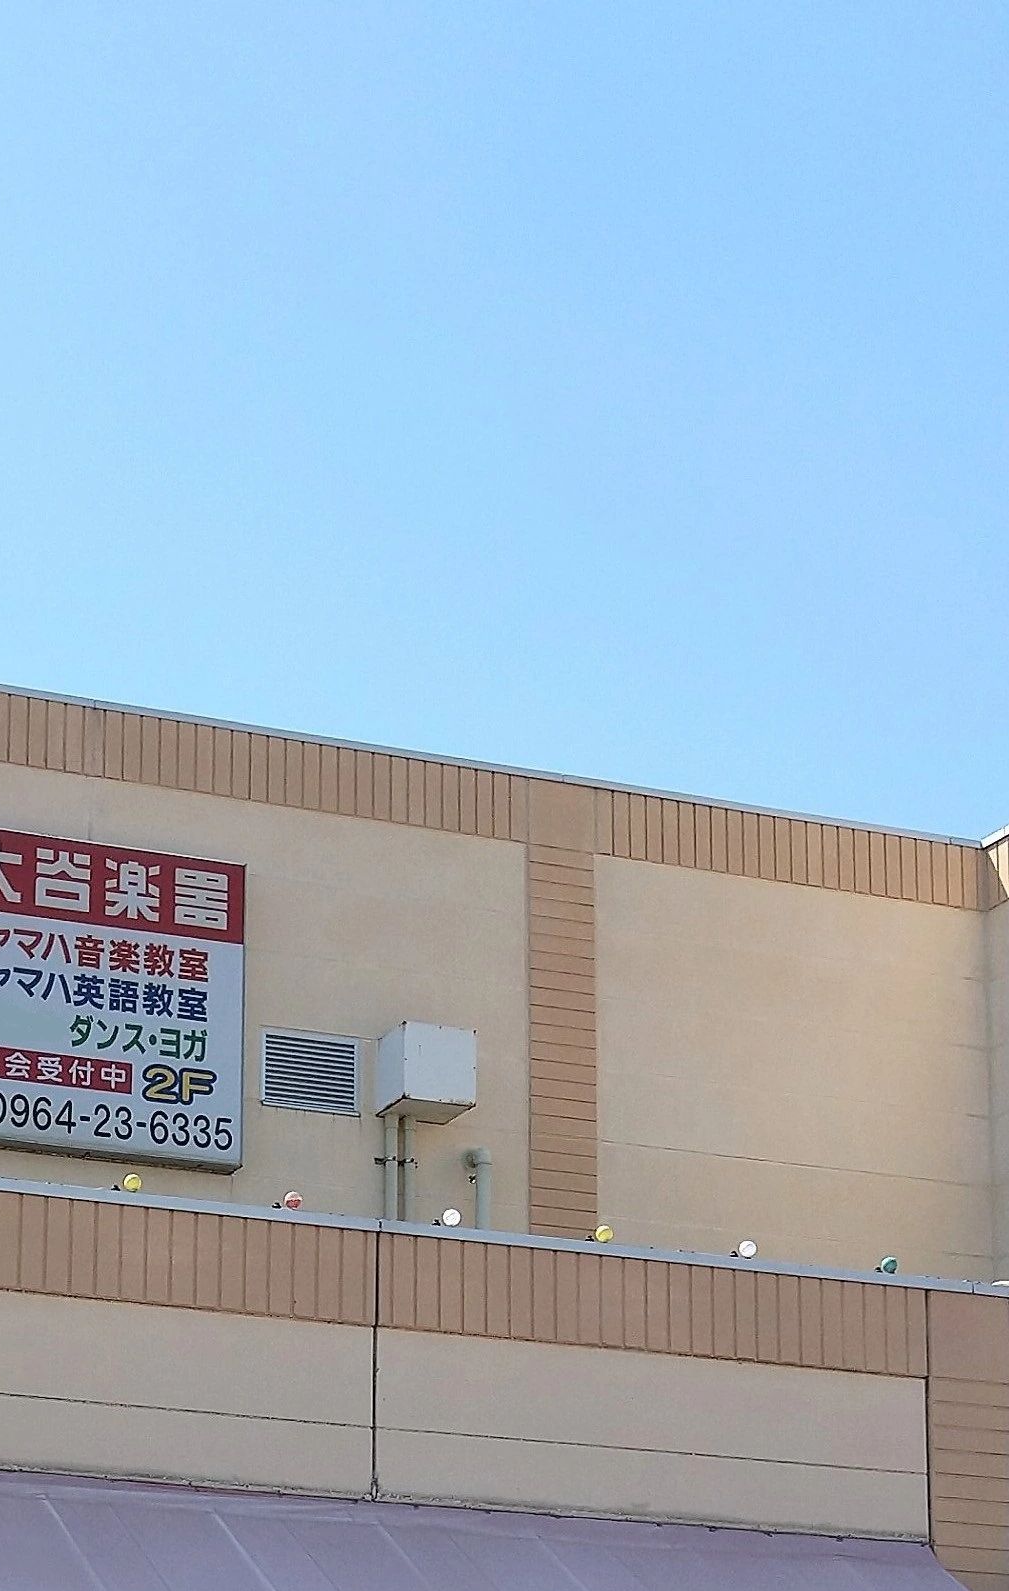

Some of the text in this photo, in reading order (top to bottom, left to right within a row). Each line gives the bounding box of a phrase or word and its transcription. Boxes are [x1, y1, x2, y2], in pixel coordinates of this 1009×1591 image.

[69, 1014, 209, 1063] ダンス・ヨガ
[142, 1063, 218, 1105] 2F
